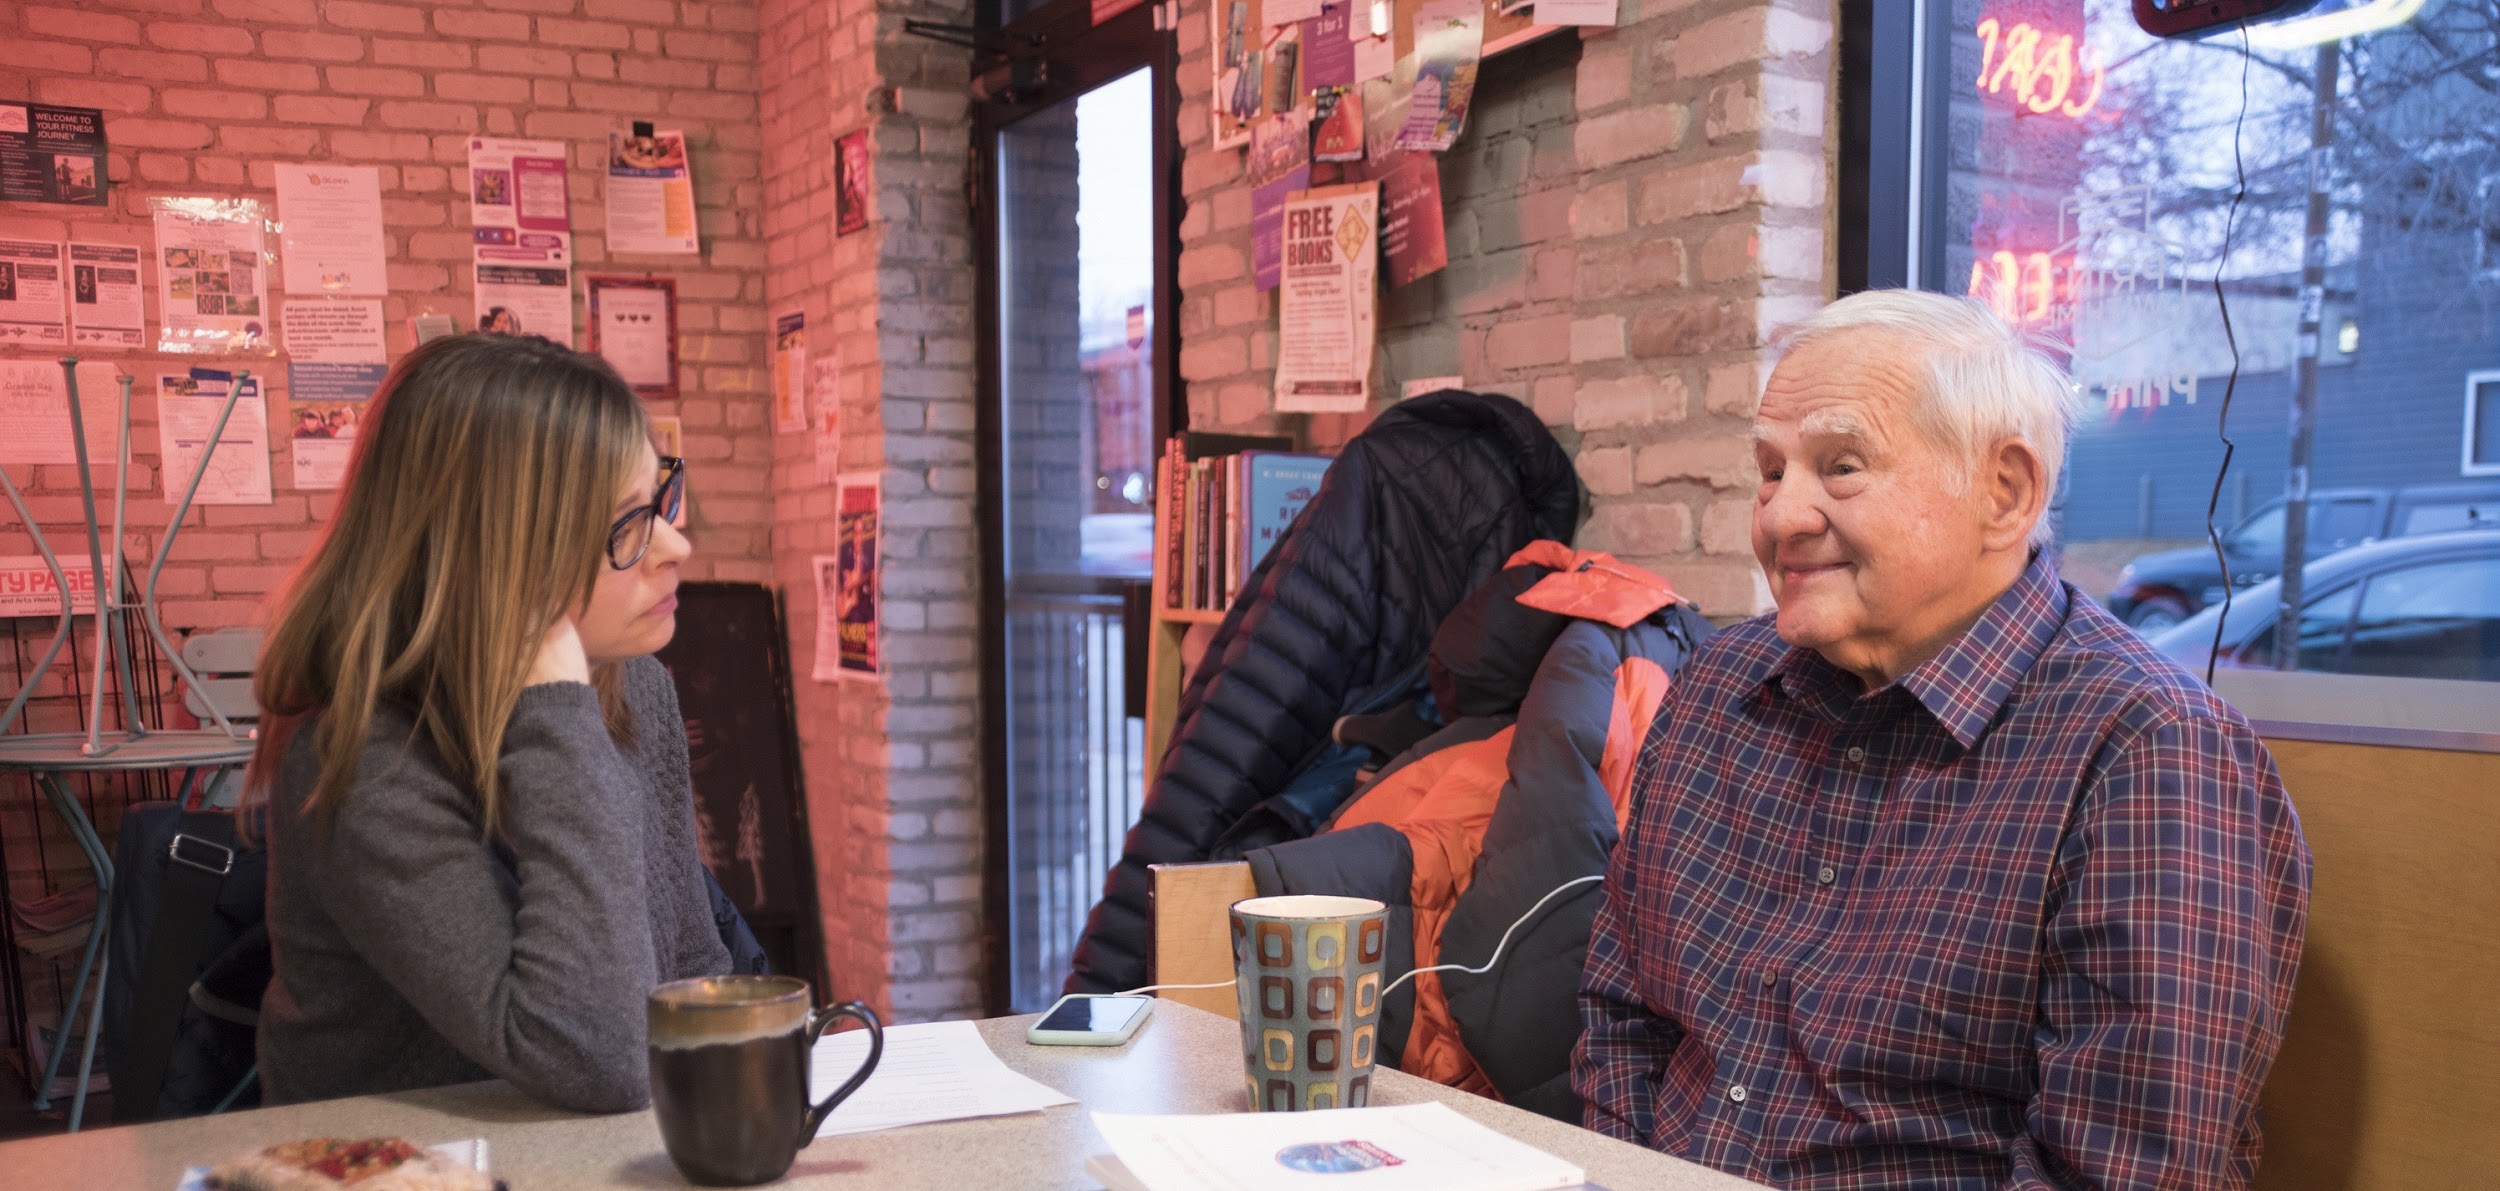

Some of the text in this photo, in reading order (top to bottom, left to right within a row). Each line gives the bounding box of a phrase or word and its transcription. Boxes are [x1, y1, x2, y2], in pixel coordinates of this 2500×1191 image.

[35, 113, 78, 124] WELCOME
[80, 115, 92, 125] TO
[35, 122, 95, 134] YOUR FITNESS
[37, 131, 76, 140] JOURNEY
[1288, 205, 1333, 240] FREE
[1288, 239, 1333, 266] BOOKS
[33, 595, 58, 604] Weekly
